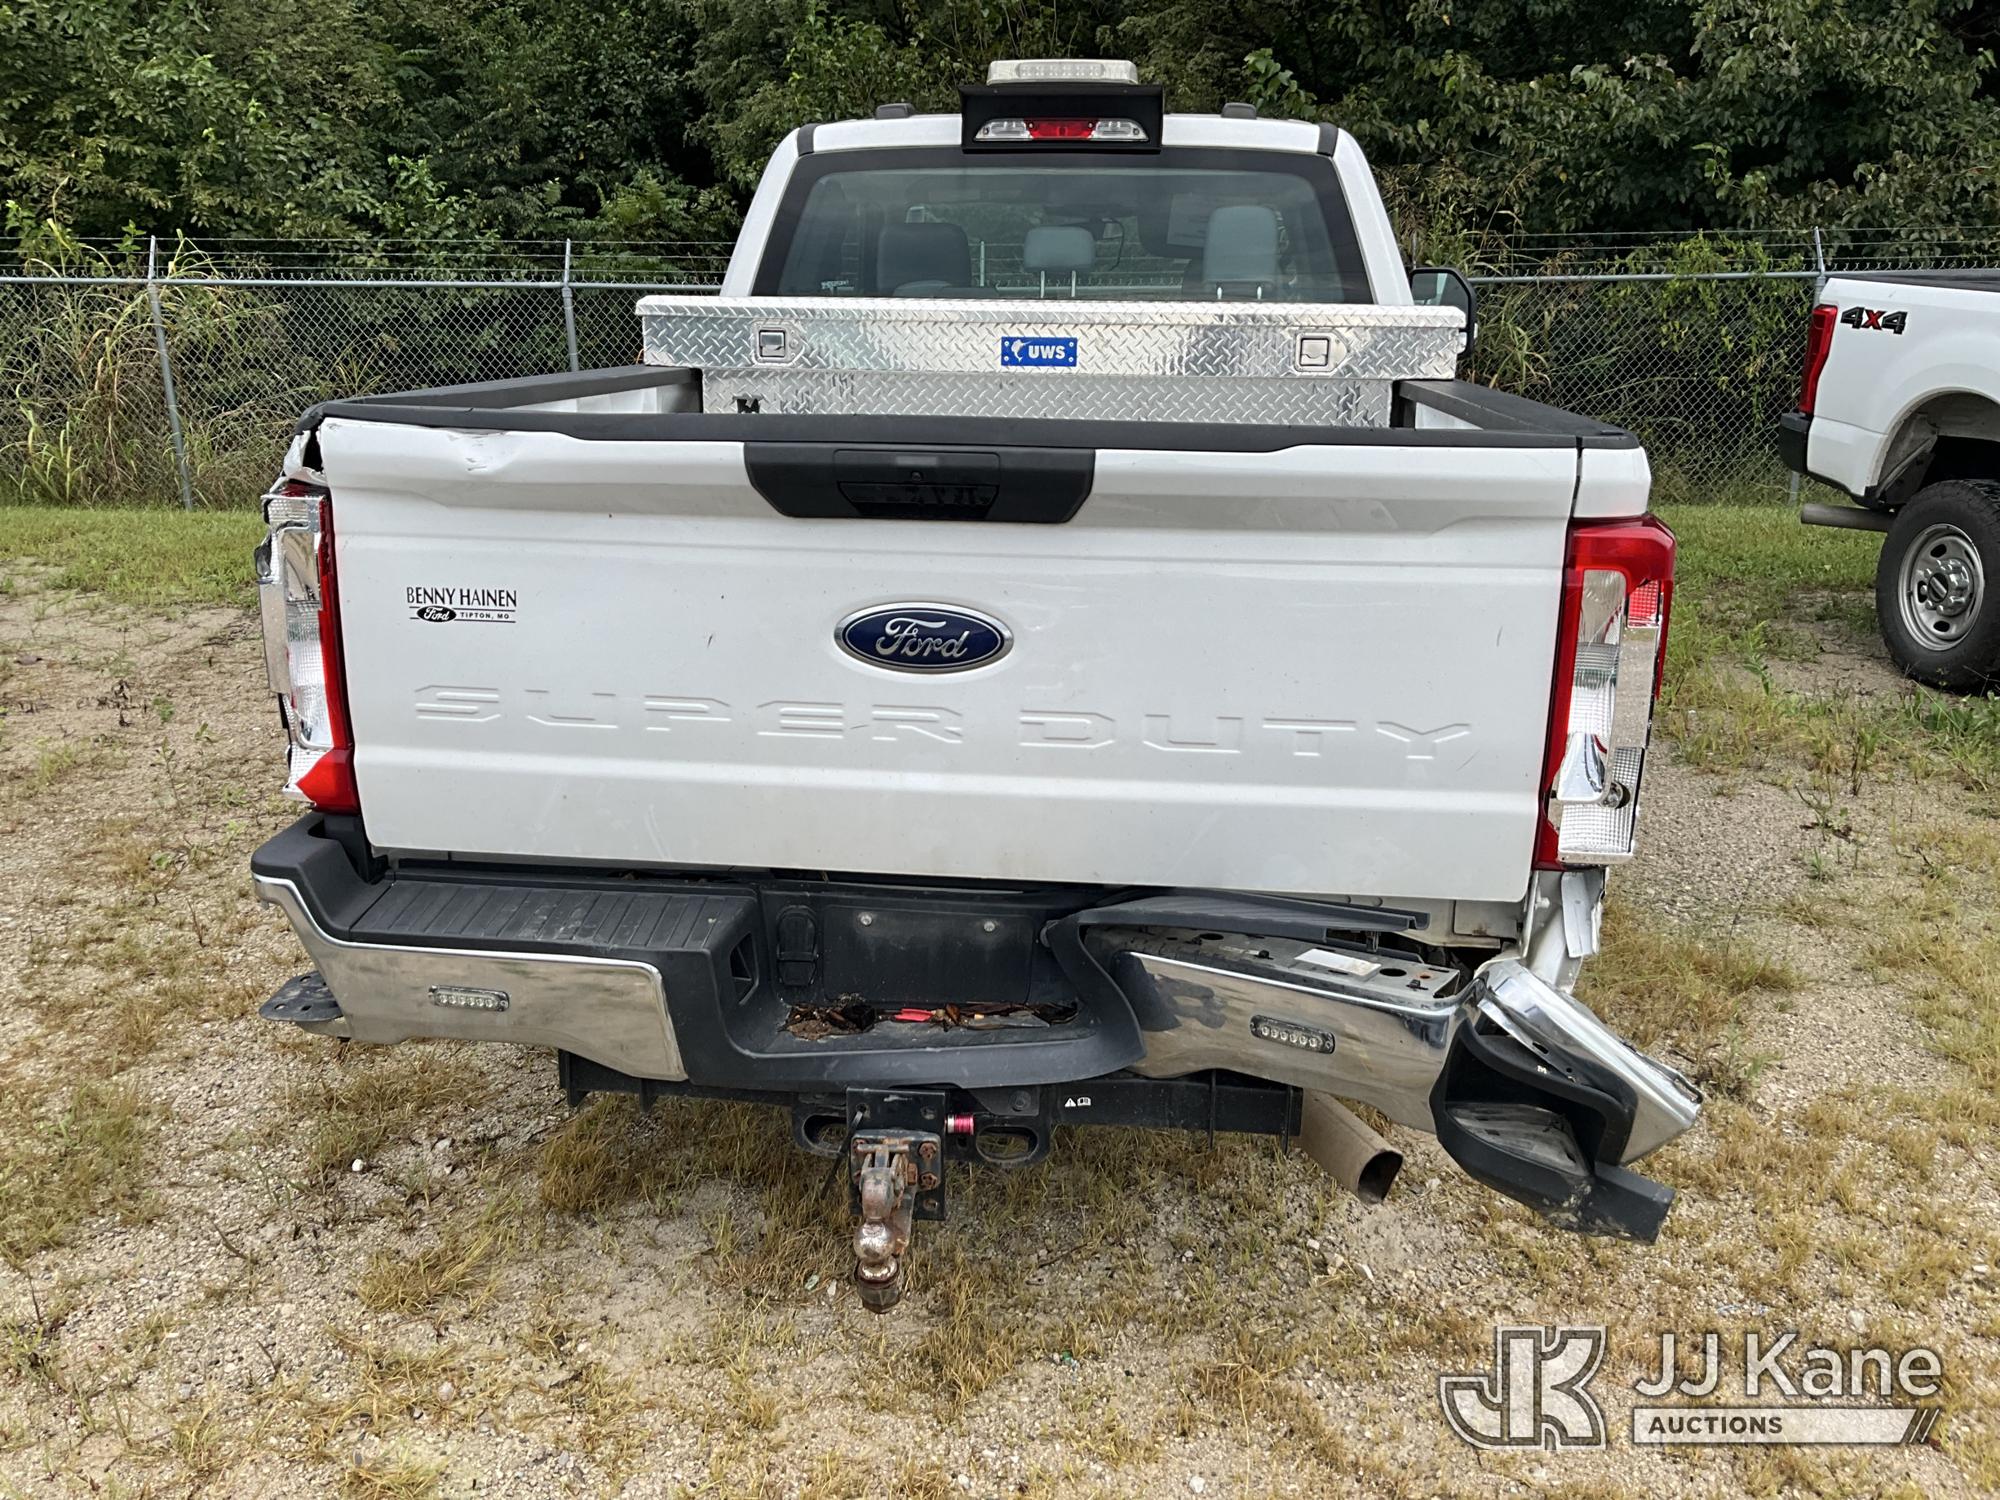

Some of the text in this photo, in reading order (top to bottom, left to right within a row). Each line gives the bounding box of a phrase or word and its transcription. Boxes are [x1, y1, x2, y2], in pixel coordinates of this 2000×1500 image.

[1028, 345, 1066, 359] UWS
[406, 586, 517, 607] BENNY HAINEN
[423, 606, 450, 620] Ford
[460, 612, 510, 620] TIPTON, MO
[875, 617, 970, 658] Ford
[415, 685, 1470, 759] SUPER DUTY
